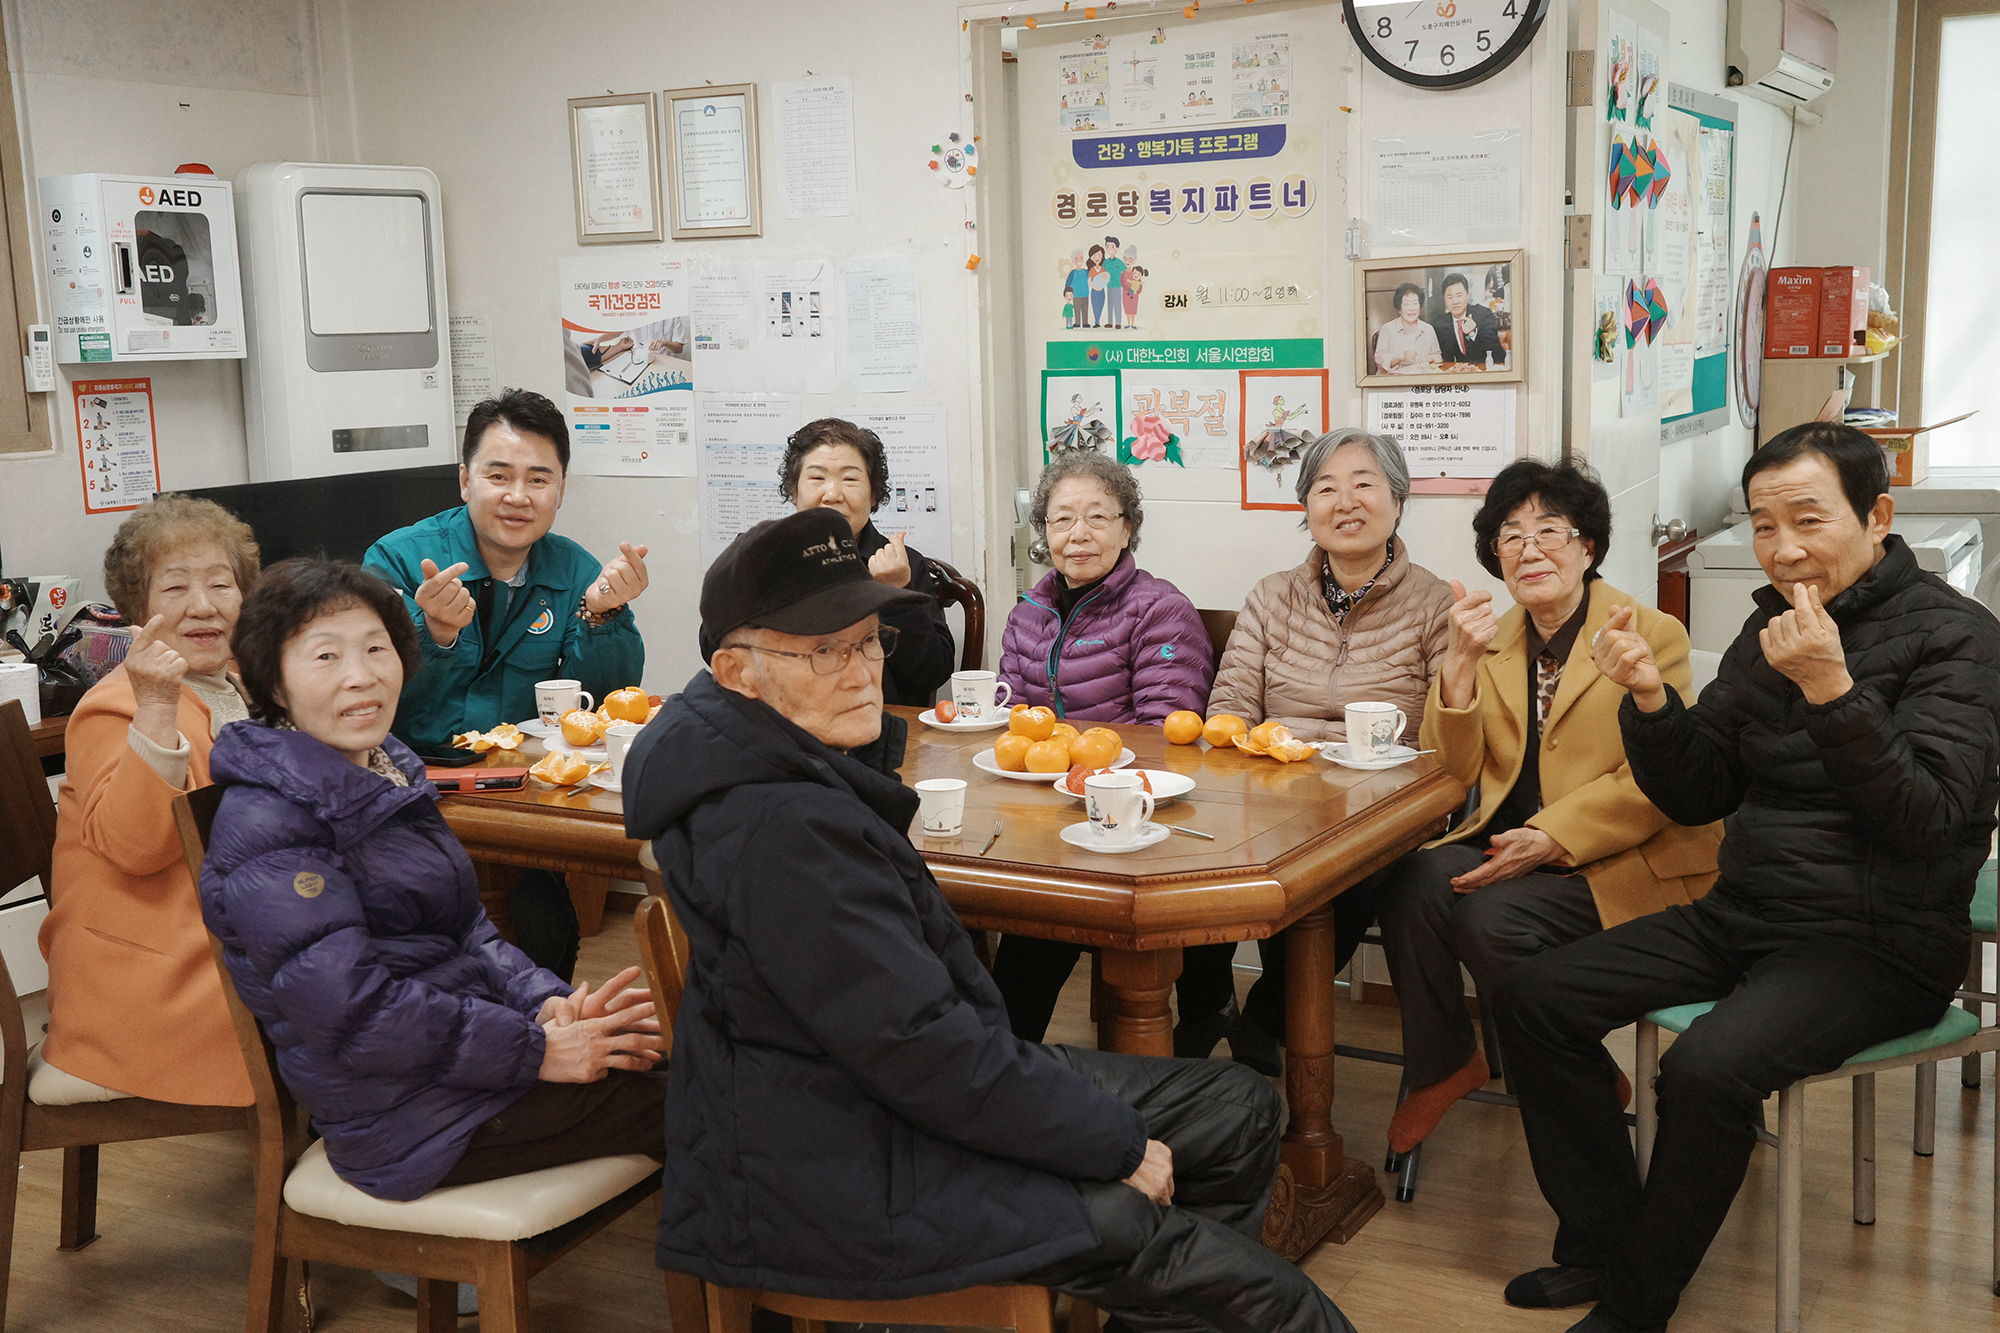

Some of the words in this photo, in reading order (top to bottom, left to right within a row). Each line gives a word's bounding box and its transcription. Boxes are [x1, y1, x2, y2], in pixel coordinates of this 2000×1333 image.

[1502, 0, 1519, 19] 4
[1377, 17, 1392, 38] 8
[1421, 18, 1473, 31] 도봉구치매안심센터
[1476, 29, 1491, 52] 5
[1404, 39, 1420, 62] 7
[1440, 44, 1456, 67] 6
[1097, 143, 1126, 161] 건강
[1136, 137, 1195, 160] 행복가득
[1198, 132, 1259, 155] 프로그램
[158, 189, 203, 207] AED
[574, 282, 591, 290] 태어날
[591, 281, 607, 290] 때부터
[633, 281, 644, 289] 모두
[1777, 274, 1812, 285] Maxim
[1164, 294, 1188, 309] 강사
[1196, 285, 1211, 305] 월
[588, 293, 661, 311] 국가건강검진
[57, 315, 92, 326] 긴급상황에만
[92, 315, 105, 324] 사용
[1104, 349, 1123, 364] (사)
[1126, 347, 1191, 364] 대한노인회
[1195, 346, 1274, 363] 서울시연합회
[1410, 385, 1432, 394] <경로당
[1434, 385, 1453, 394] 담당자
[1455, 385, 1471, 394] 안내>
[81, 398, 86, 409] 1
[1381, 401, 1405, 409] [경로과장]
[83, 418, 90, 430] 2
[1409, 433, 1420, 441] 오전
[1420, 433, 1432, 441] 09시
[85, 439, 92, 450] 3
[87, 460, 94, 470] 4
[89, 479, 96, 490] 5
[803, 543, 828, 558] ATTO
[822, 553, 857, 566] ATHLETICS
